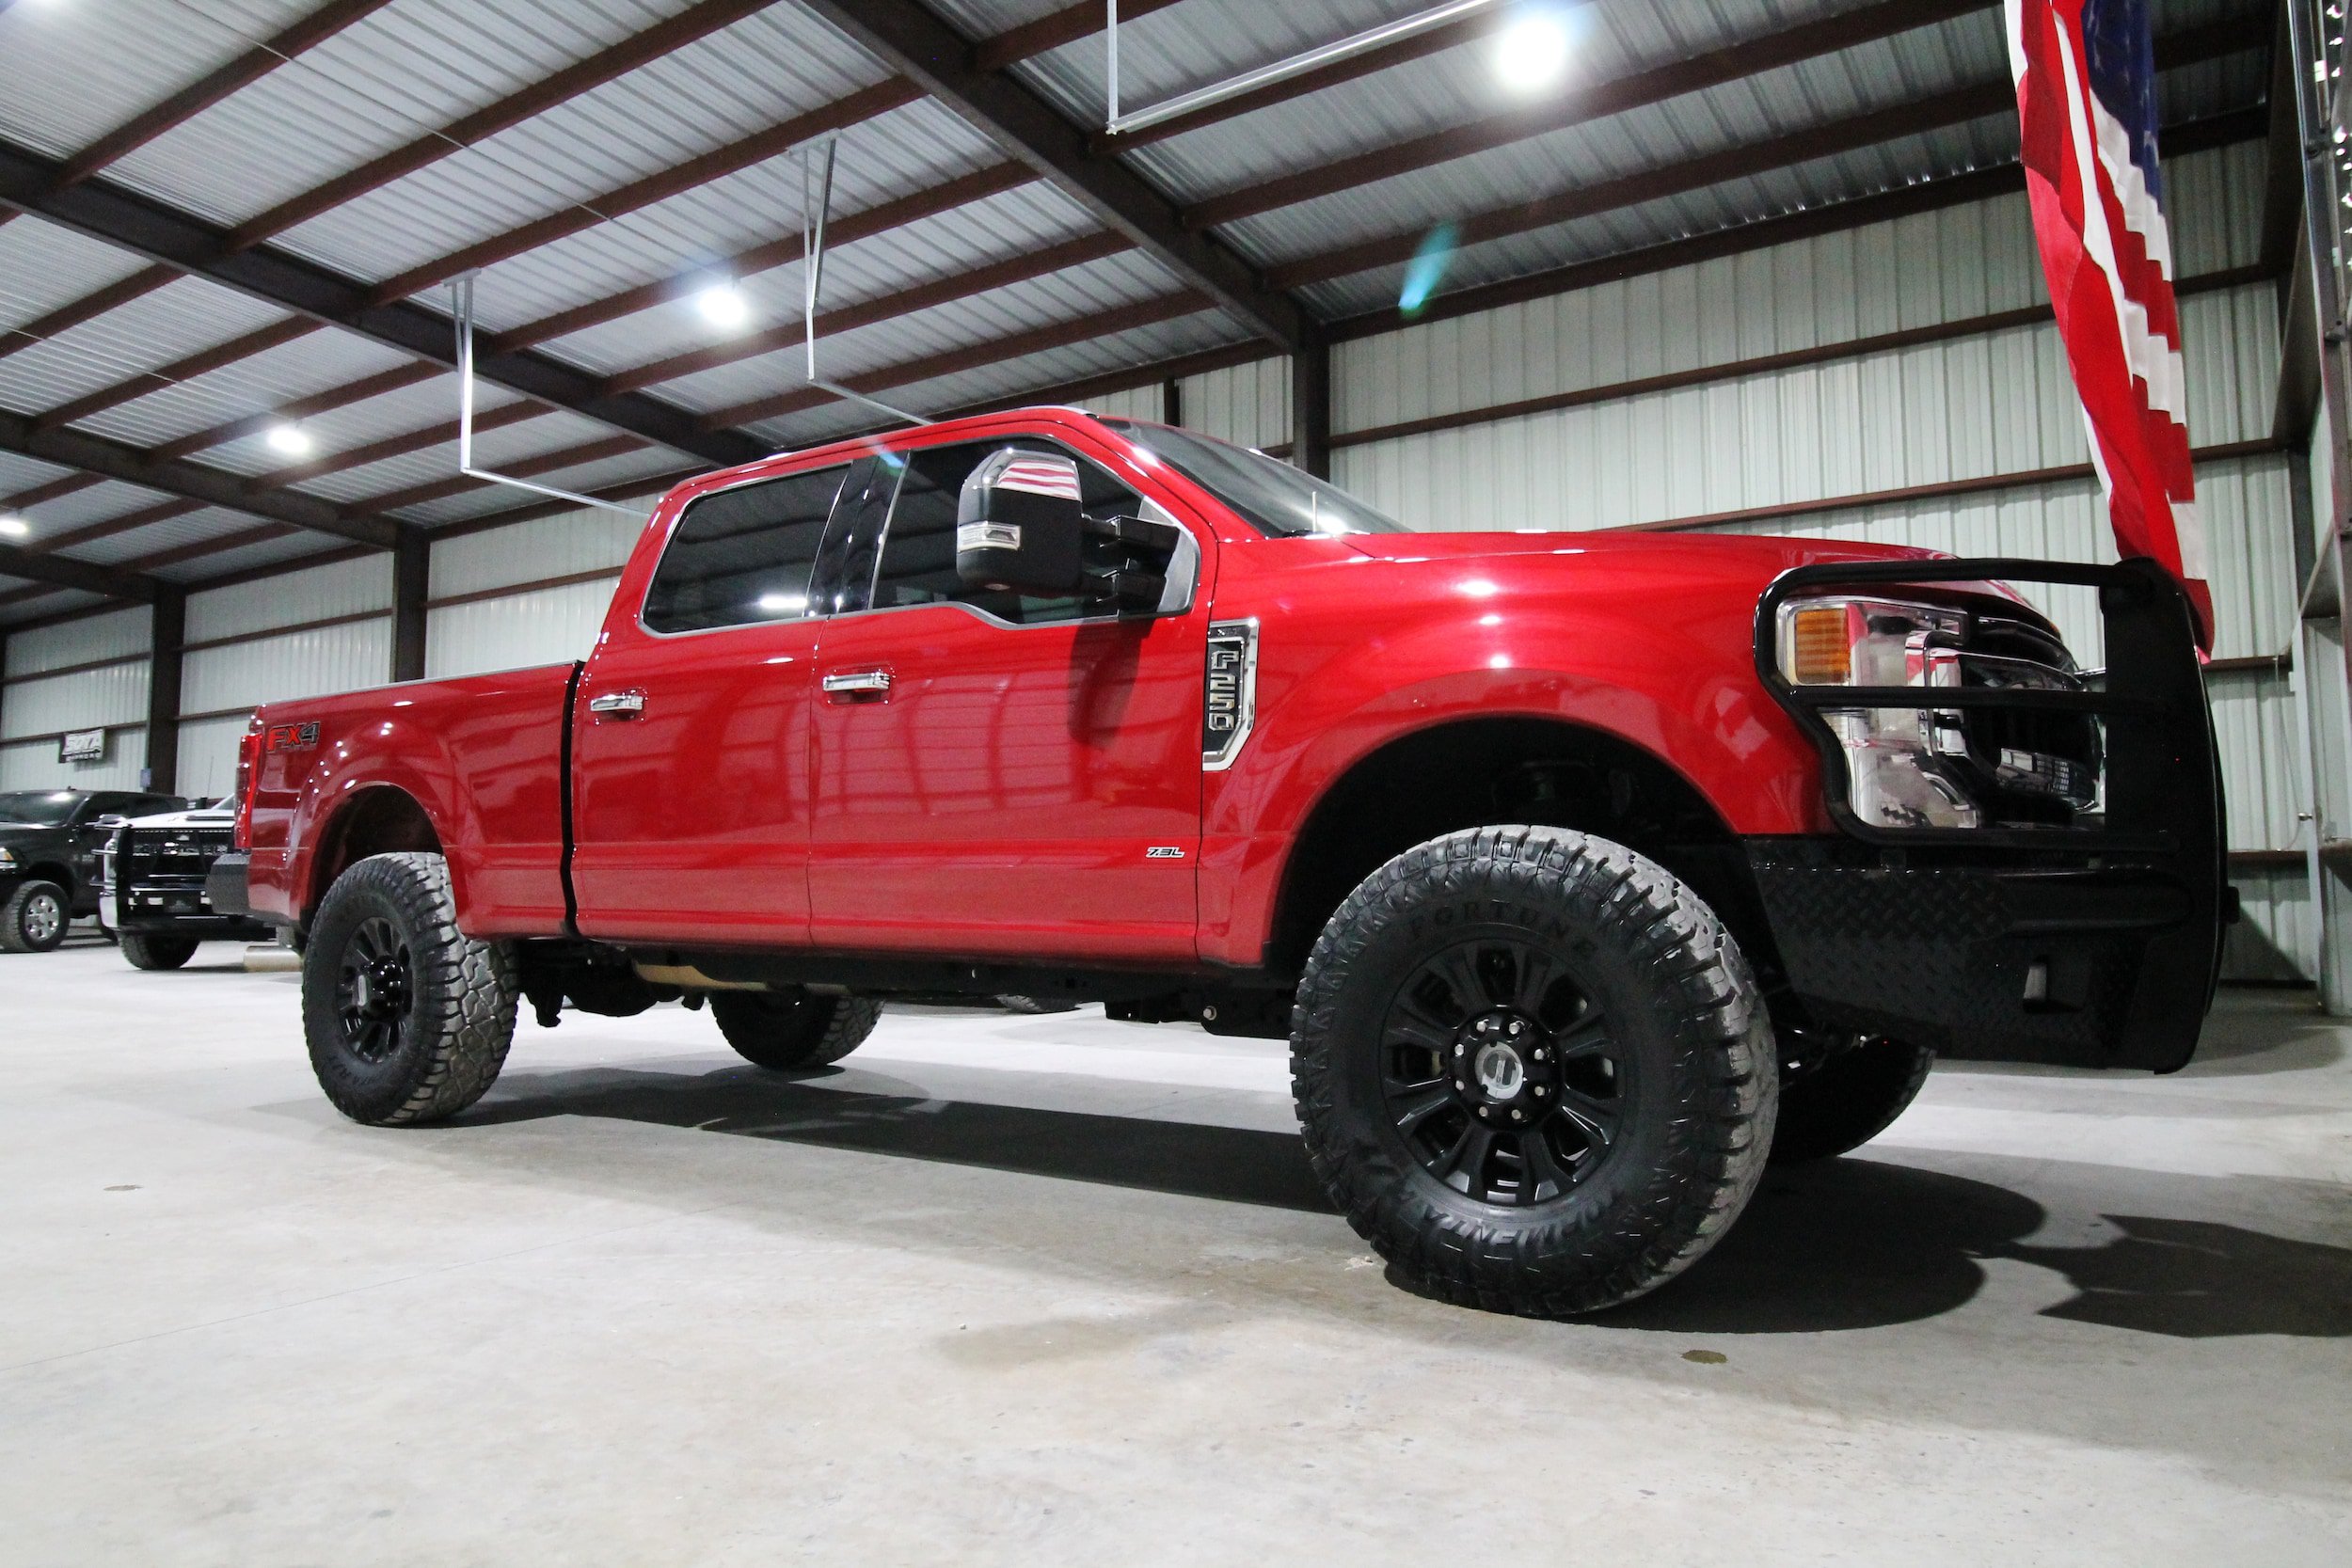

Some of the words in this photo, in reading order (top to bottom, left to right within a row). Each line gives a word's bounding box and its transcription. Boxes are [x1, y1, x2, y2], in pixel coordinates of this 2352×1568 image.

[267, 722, 320, 752] FX4
[1146, 847, 1185, 858] 7.3L
[1409, 898, 1597, 954] FORTUNE
